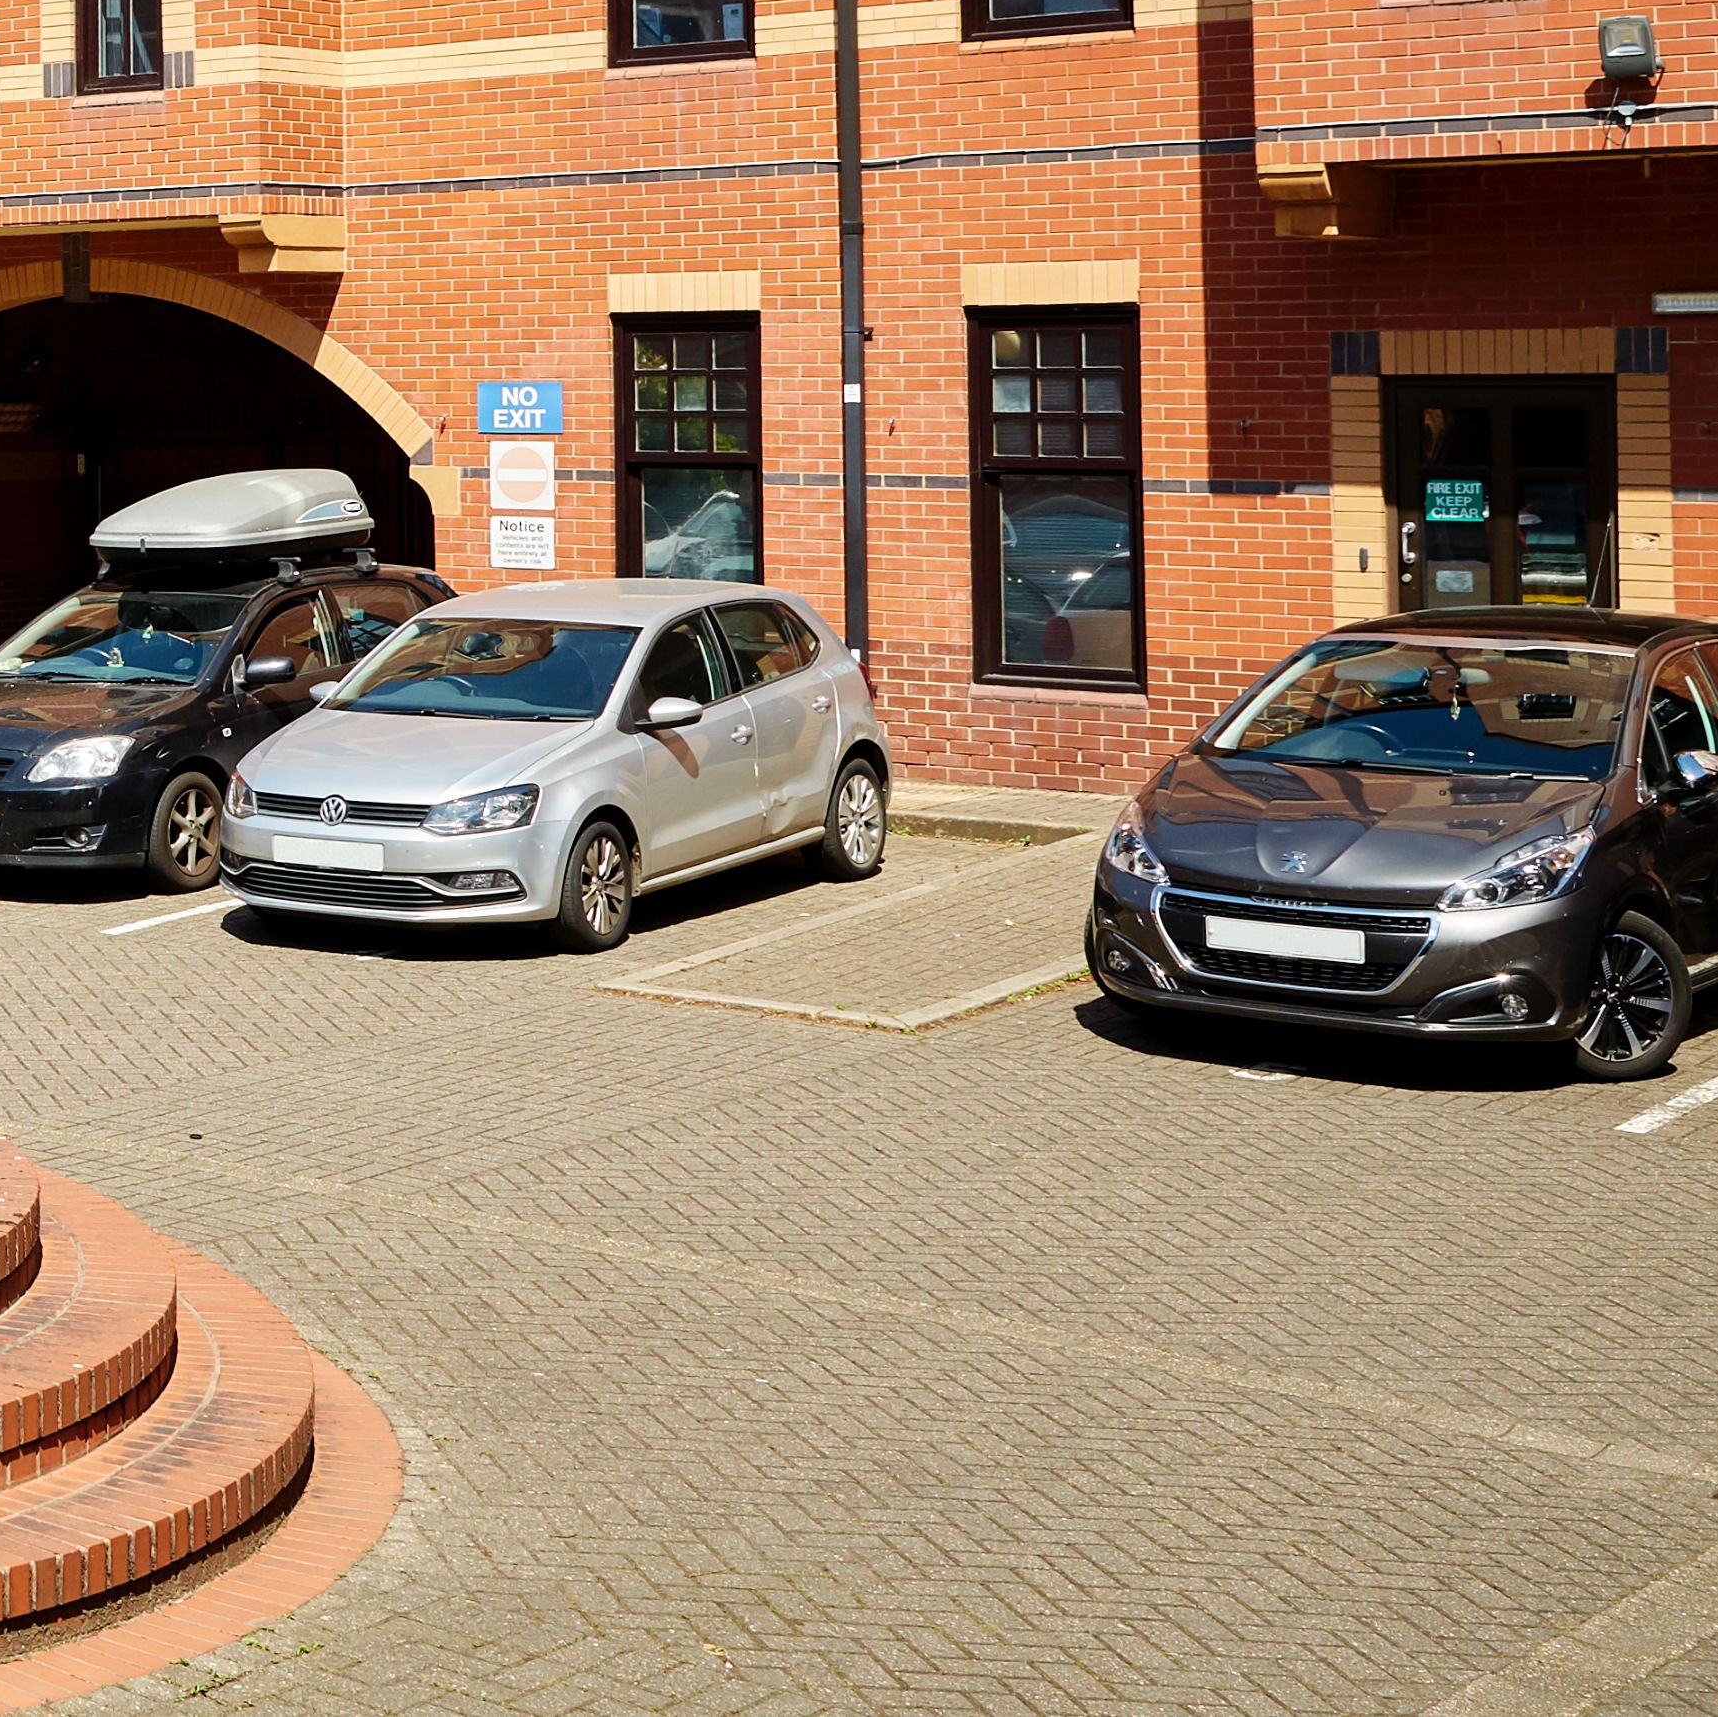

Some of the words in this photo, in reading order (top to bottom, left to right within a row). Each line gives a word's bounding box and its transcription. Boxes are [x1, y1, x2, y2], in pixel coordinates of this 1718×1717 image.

[502, 386, 538, 406] NO
[493, 409, 547, 428] EXIT
[1427, 482, 1452, 494] FIRE
[1455, 482, 1482, 494] EXIT
[1435, 496, 1472, 506] KEEP
[1431, 507, 1479, 518] CLEAR
[499, 520, 544, 532] Notice
